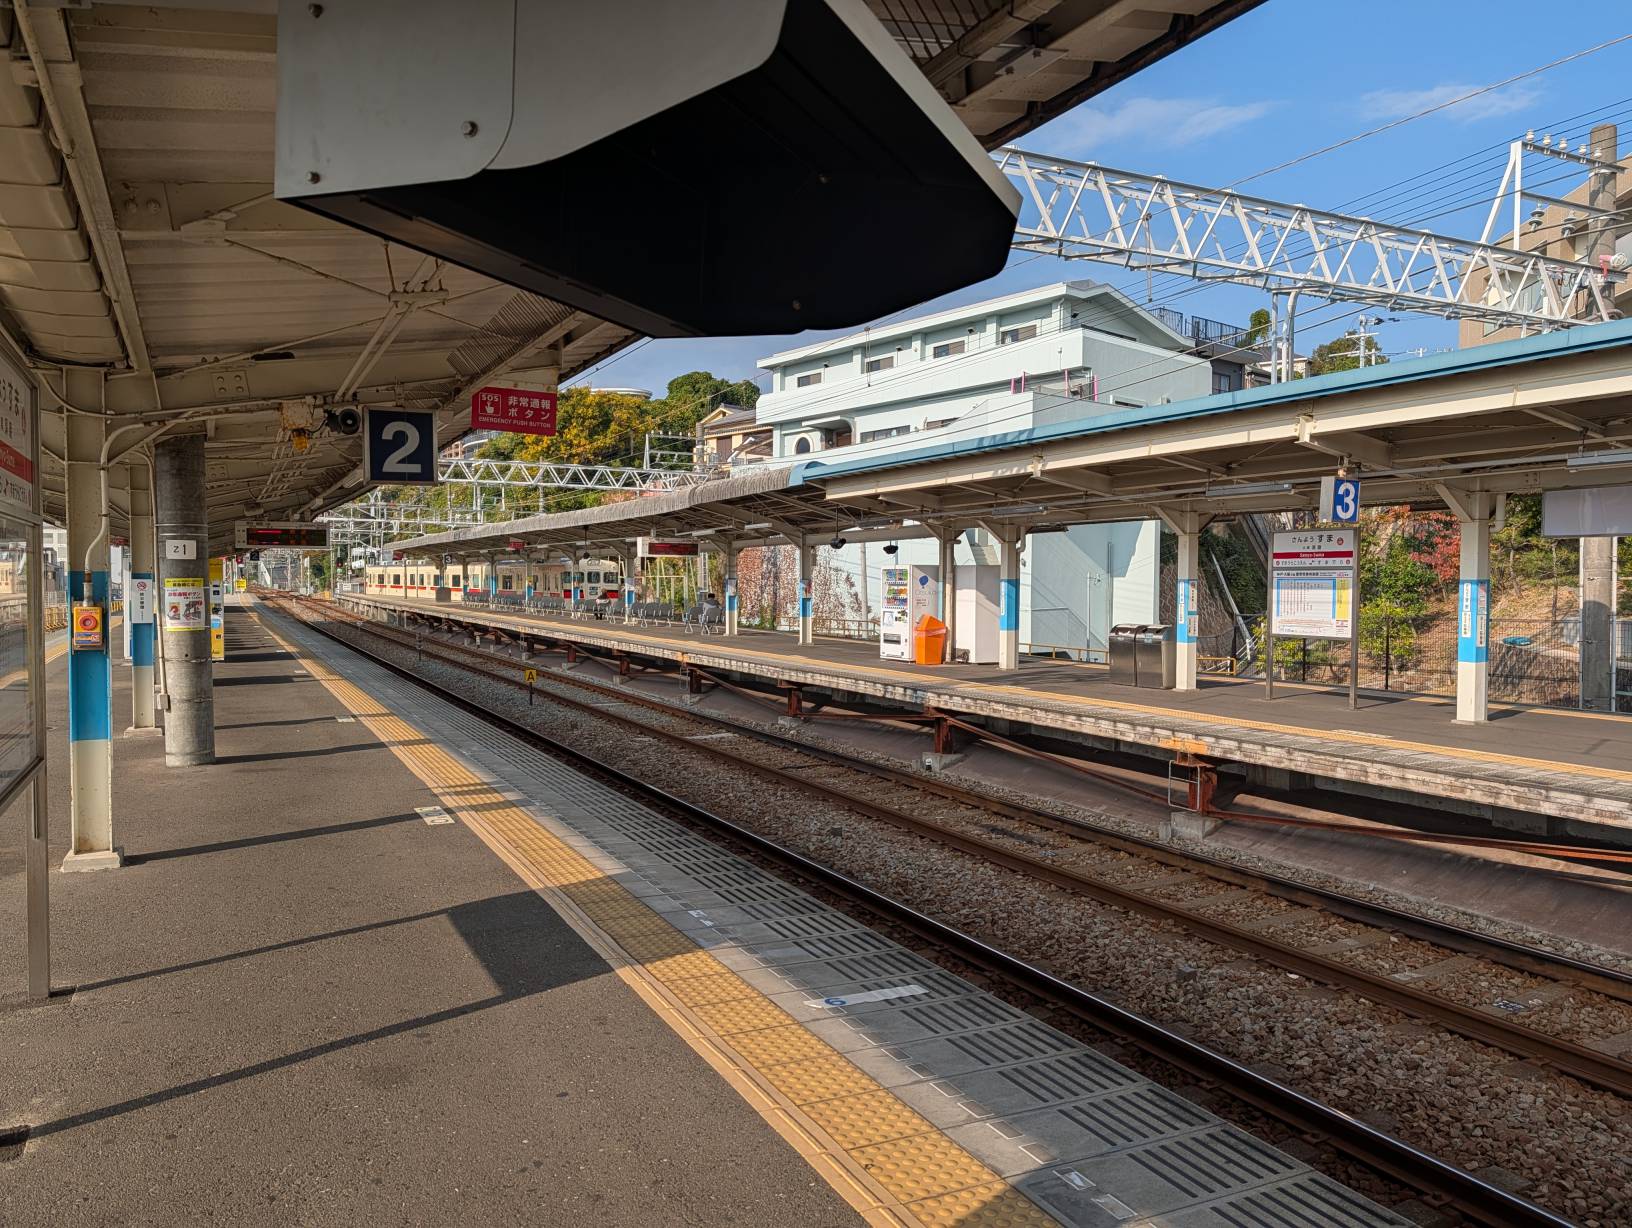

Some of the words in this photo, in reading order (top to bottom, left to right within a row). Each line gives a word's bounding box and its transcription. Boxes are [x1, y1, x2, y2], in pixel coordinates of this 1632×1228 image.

[481, 394, 499, 402] SOS
[508, 396, 551, 409] 非常通報
[508, 407, 550, 420] ボタン
[479, 416, 512, 424] EMERGENCY
[381, 421, 422, 473] 2
[1336, 482, 1355, 520] 3
[445, 555, 452, 563] 3
[527, 671, 535, 681] A
